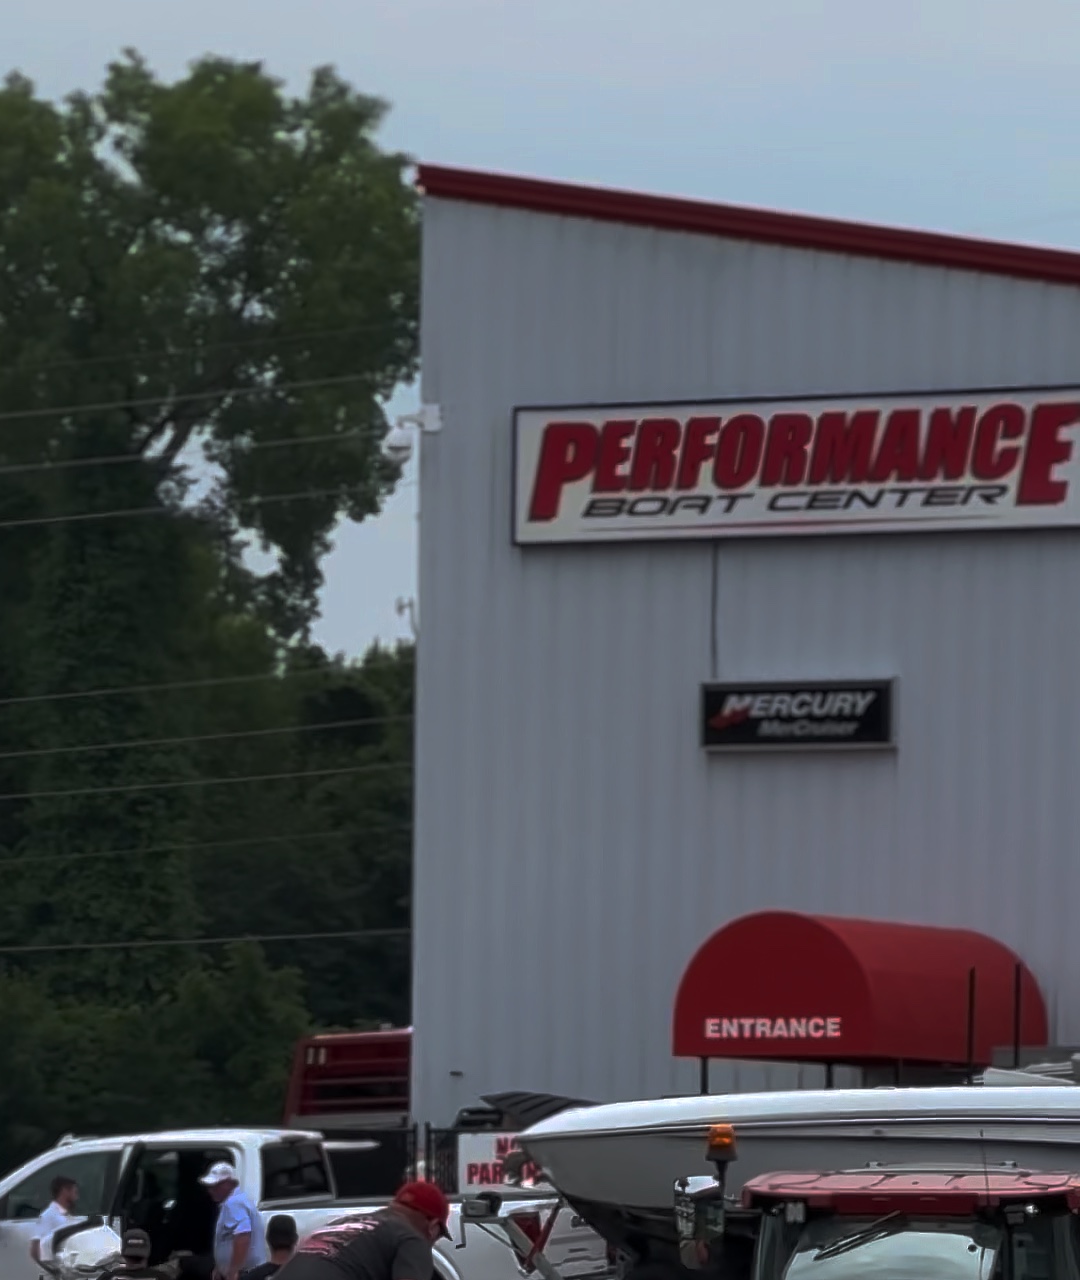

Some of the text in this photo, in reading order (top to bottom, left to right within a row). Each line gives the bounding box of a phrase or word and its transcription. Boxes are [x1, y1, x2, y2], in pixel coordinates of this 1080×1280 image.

[527, 401, 1080, 523] PERFORMANCE
[581, 484, 1008, 519] BOAT CENTER
[722, 690, 876, 718] MERCURY
[704, 1016, 842, 1040] ENTRANCE
